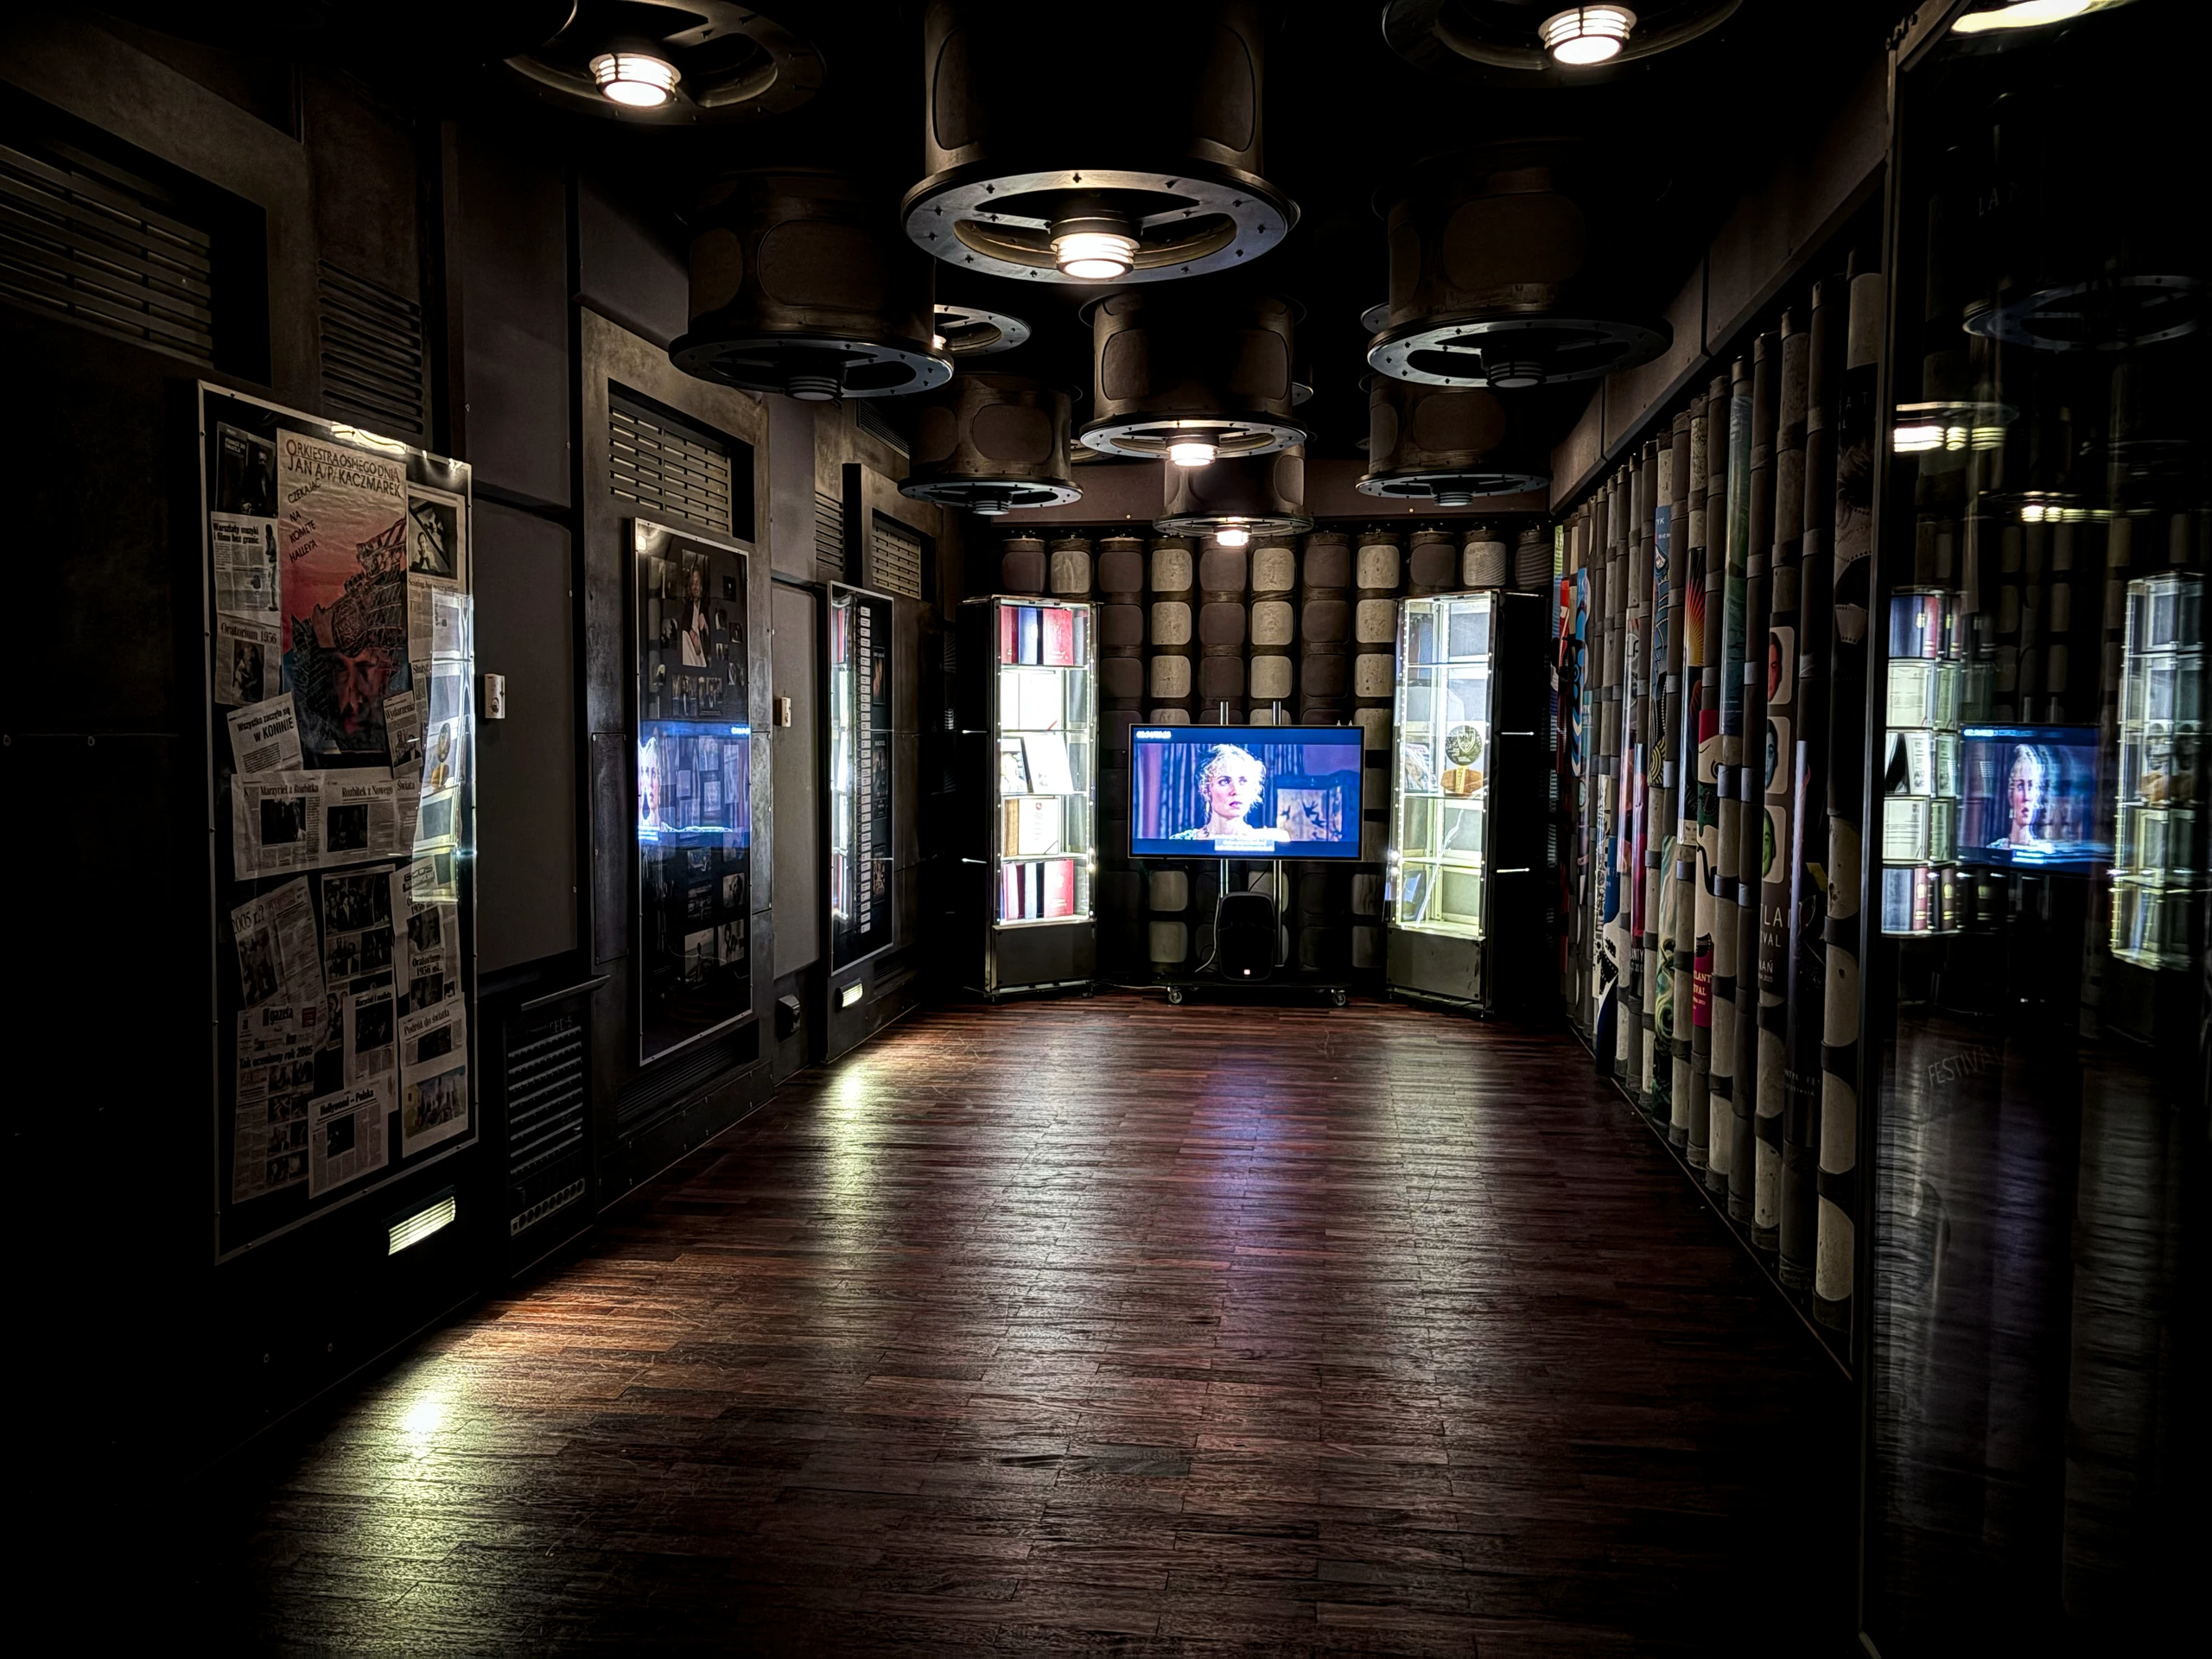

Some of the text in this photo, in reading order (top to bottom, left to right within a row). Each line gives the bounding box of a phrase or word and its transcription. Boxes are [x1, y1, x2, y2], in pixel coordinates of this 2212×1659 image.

[286, 439, 340, 467] ORKIESTRA
[378, 465, 400, 484] DNIA
[288, 455, 313, 476] JAN
[338, 468, 404, 499] KACZMAREK
[289, 510, 302, 523] NA
[220, 622, 277, 645] Oratorium 1956
[237, 716, 263, 733] Wszystko
[262, 717, 295, 740] KONINIE
[372, 785, 393, 795] Nowego
[416, 965, 431, 976] 1956
[270, 1006, 294, 1026] gazeta
[423, 1016, 431, 1027] do
[296, 1046, 314, 1058] 2005
[320, 1096, 350, 1116] Hollywood
[355, 1089, 375, 1103] Polska
